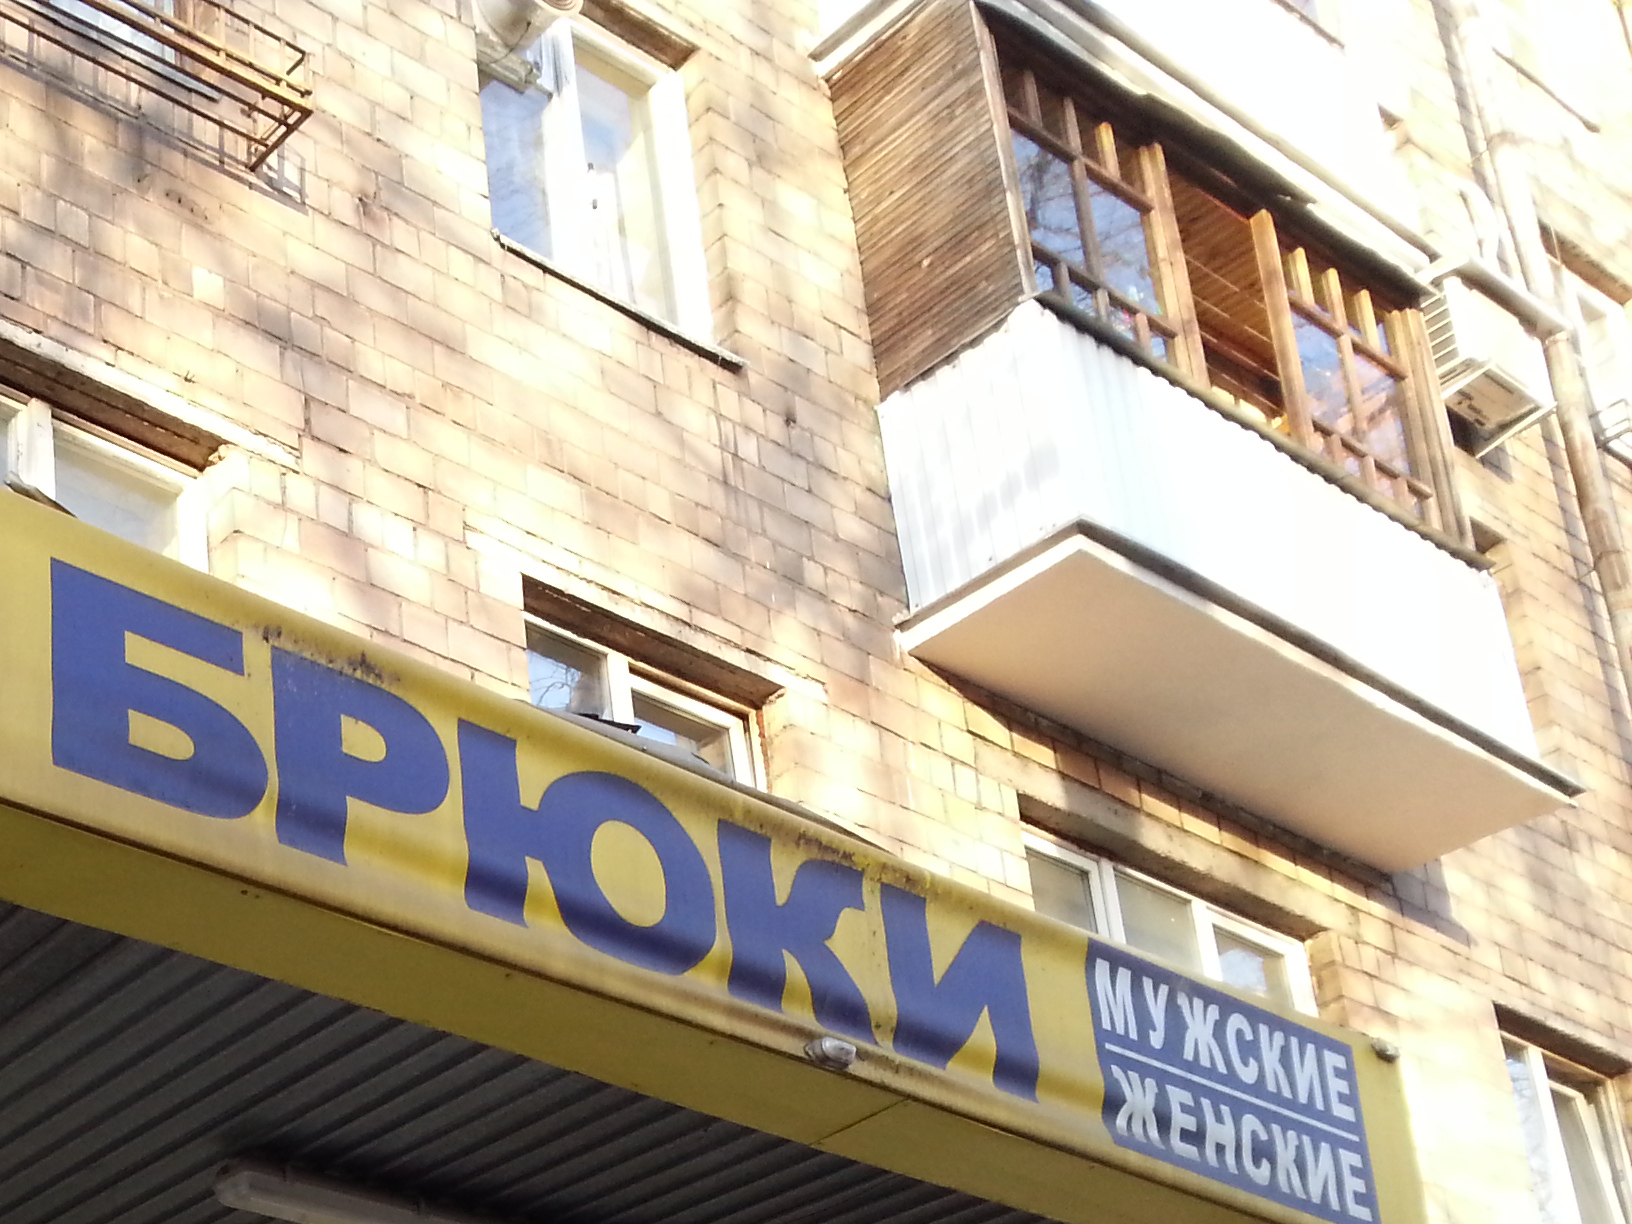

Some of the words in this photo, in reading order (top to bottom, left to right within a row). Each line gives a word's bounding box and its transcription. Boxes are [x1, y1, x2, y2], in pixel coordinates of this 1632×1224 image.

[50, 557, 1040, 1103] БРЮКИ
[1094, 958, 1357, 1123] МУЖСКИЕ
[1111, 1065, 1372, 1221] ЖЕНСКИЕ
